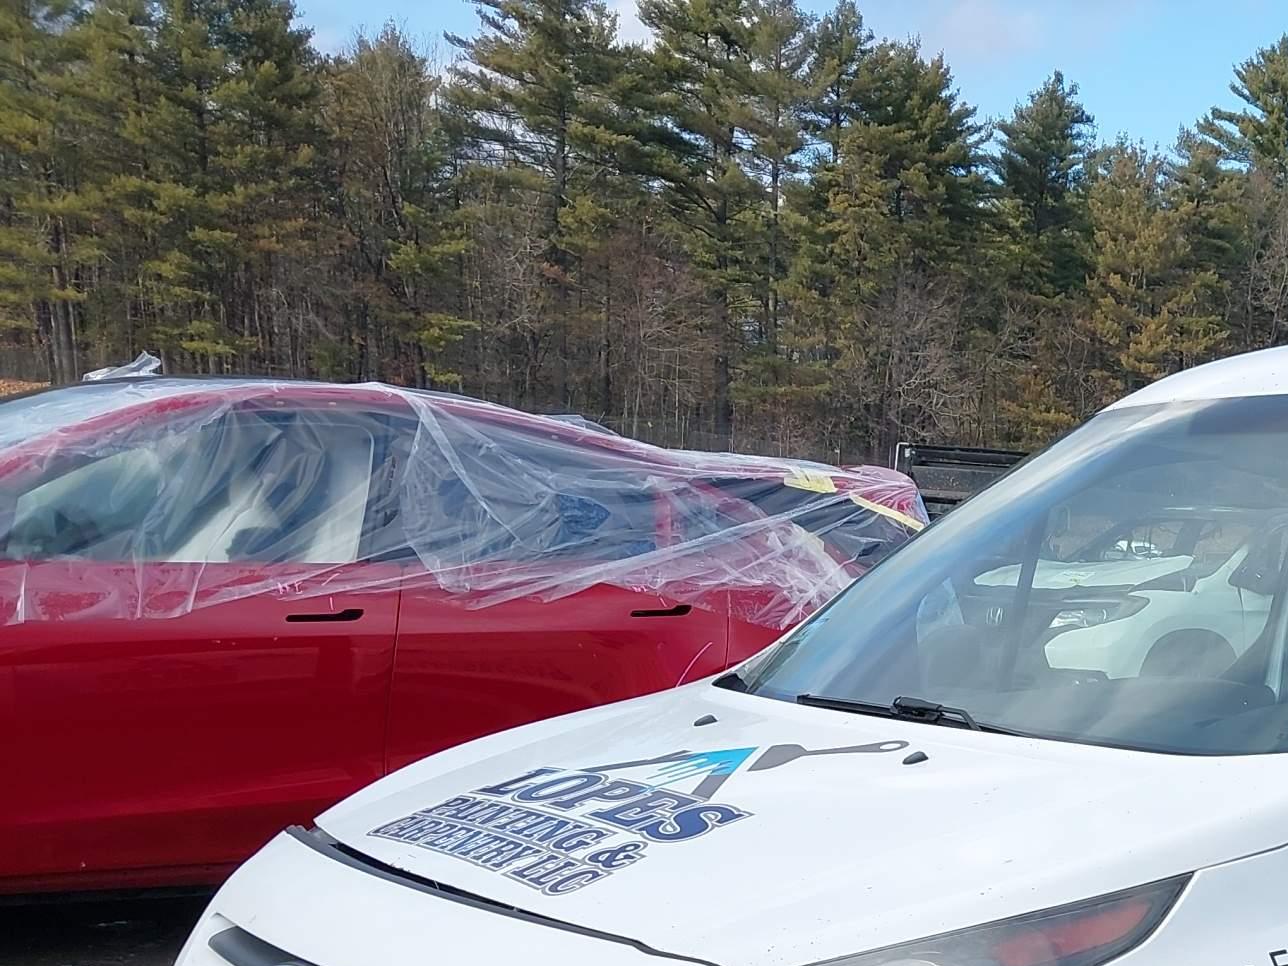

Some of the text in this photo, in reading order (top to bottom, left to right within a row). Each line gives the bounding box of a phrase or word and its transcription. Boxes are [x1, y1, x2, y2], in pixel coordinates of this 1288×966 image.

[427, 796, 643, 869] PAINTING &
[482, 768, 750, 842] LOPES
[374, 817, 602, 895] CARPENTRY LLC
